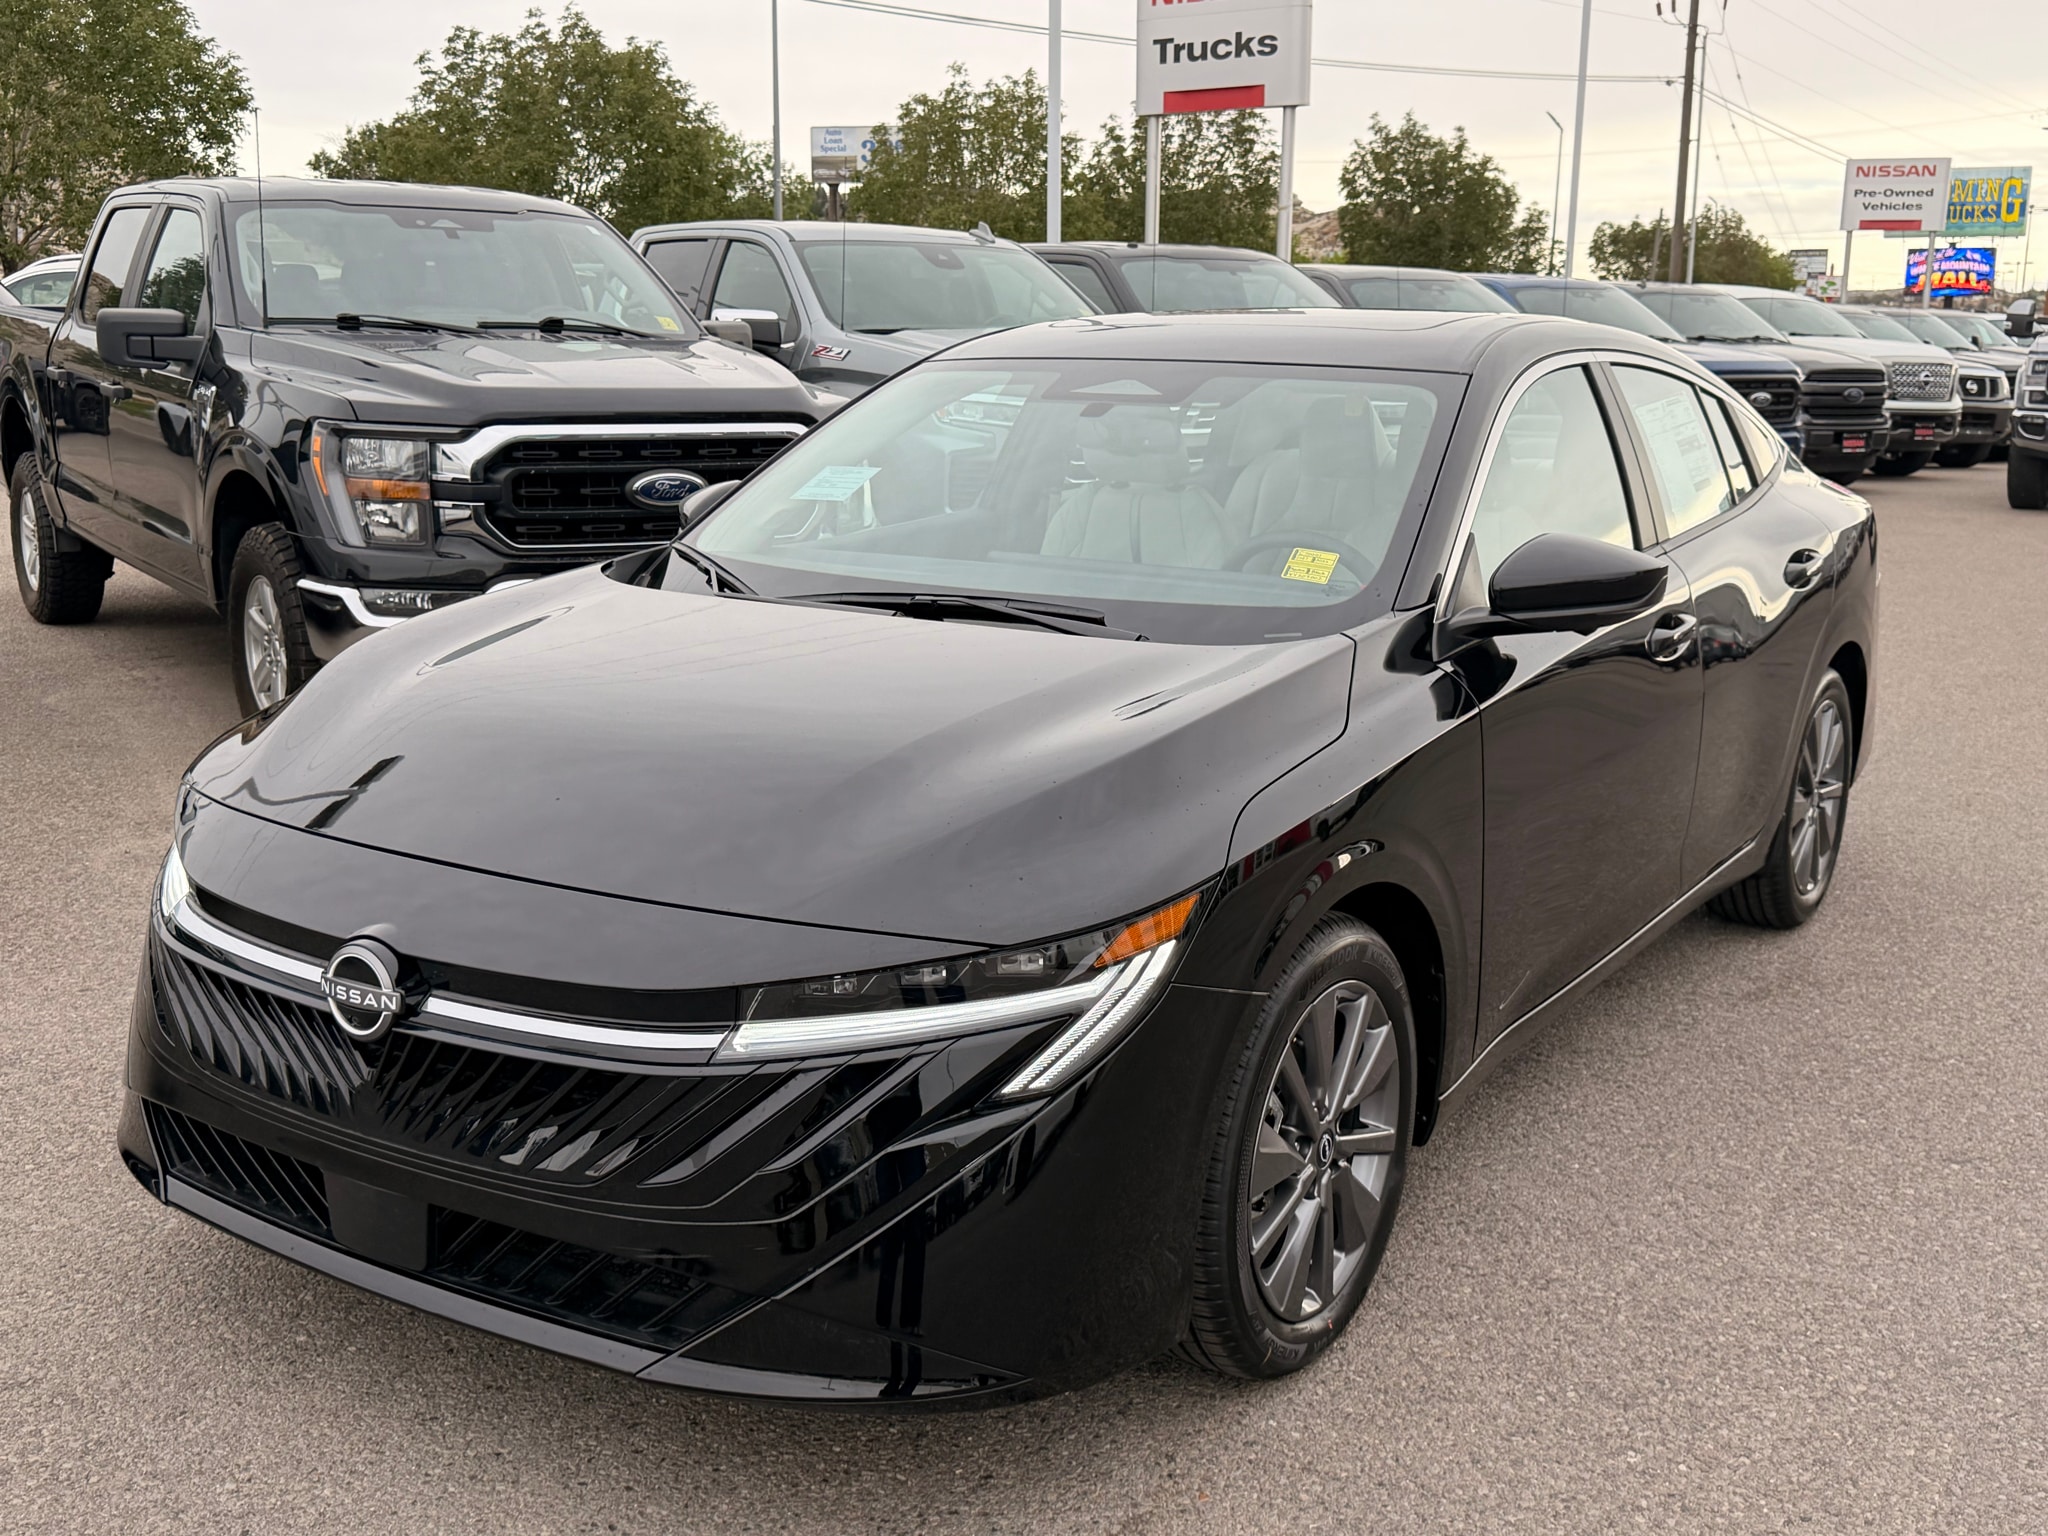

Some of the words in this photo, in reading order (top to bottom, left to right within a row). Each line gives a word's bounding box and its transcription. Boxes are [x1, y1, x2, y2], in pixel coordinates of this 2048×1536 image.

[1153, 32, 1278, 65] Trucks
[820, 144, 847, 154] Special
[1855, 164, 1937, 178] NISSAN
[1854, 188, 1935, 198] Pre-Owned
[1862, 202, 1923, 211] Vehicles
[1948, 205, 1998, 224] UCKS
[651, 480, 690, 499] Ford
[321, 978, 397, 1010] NISSAN
